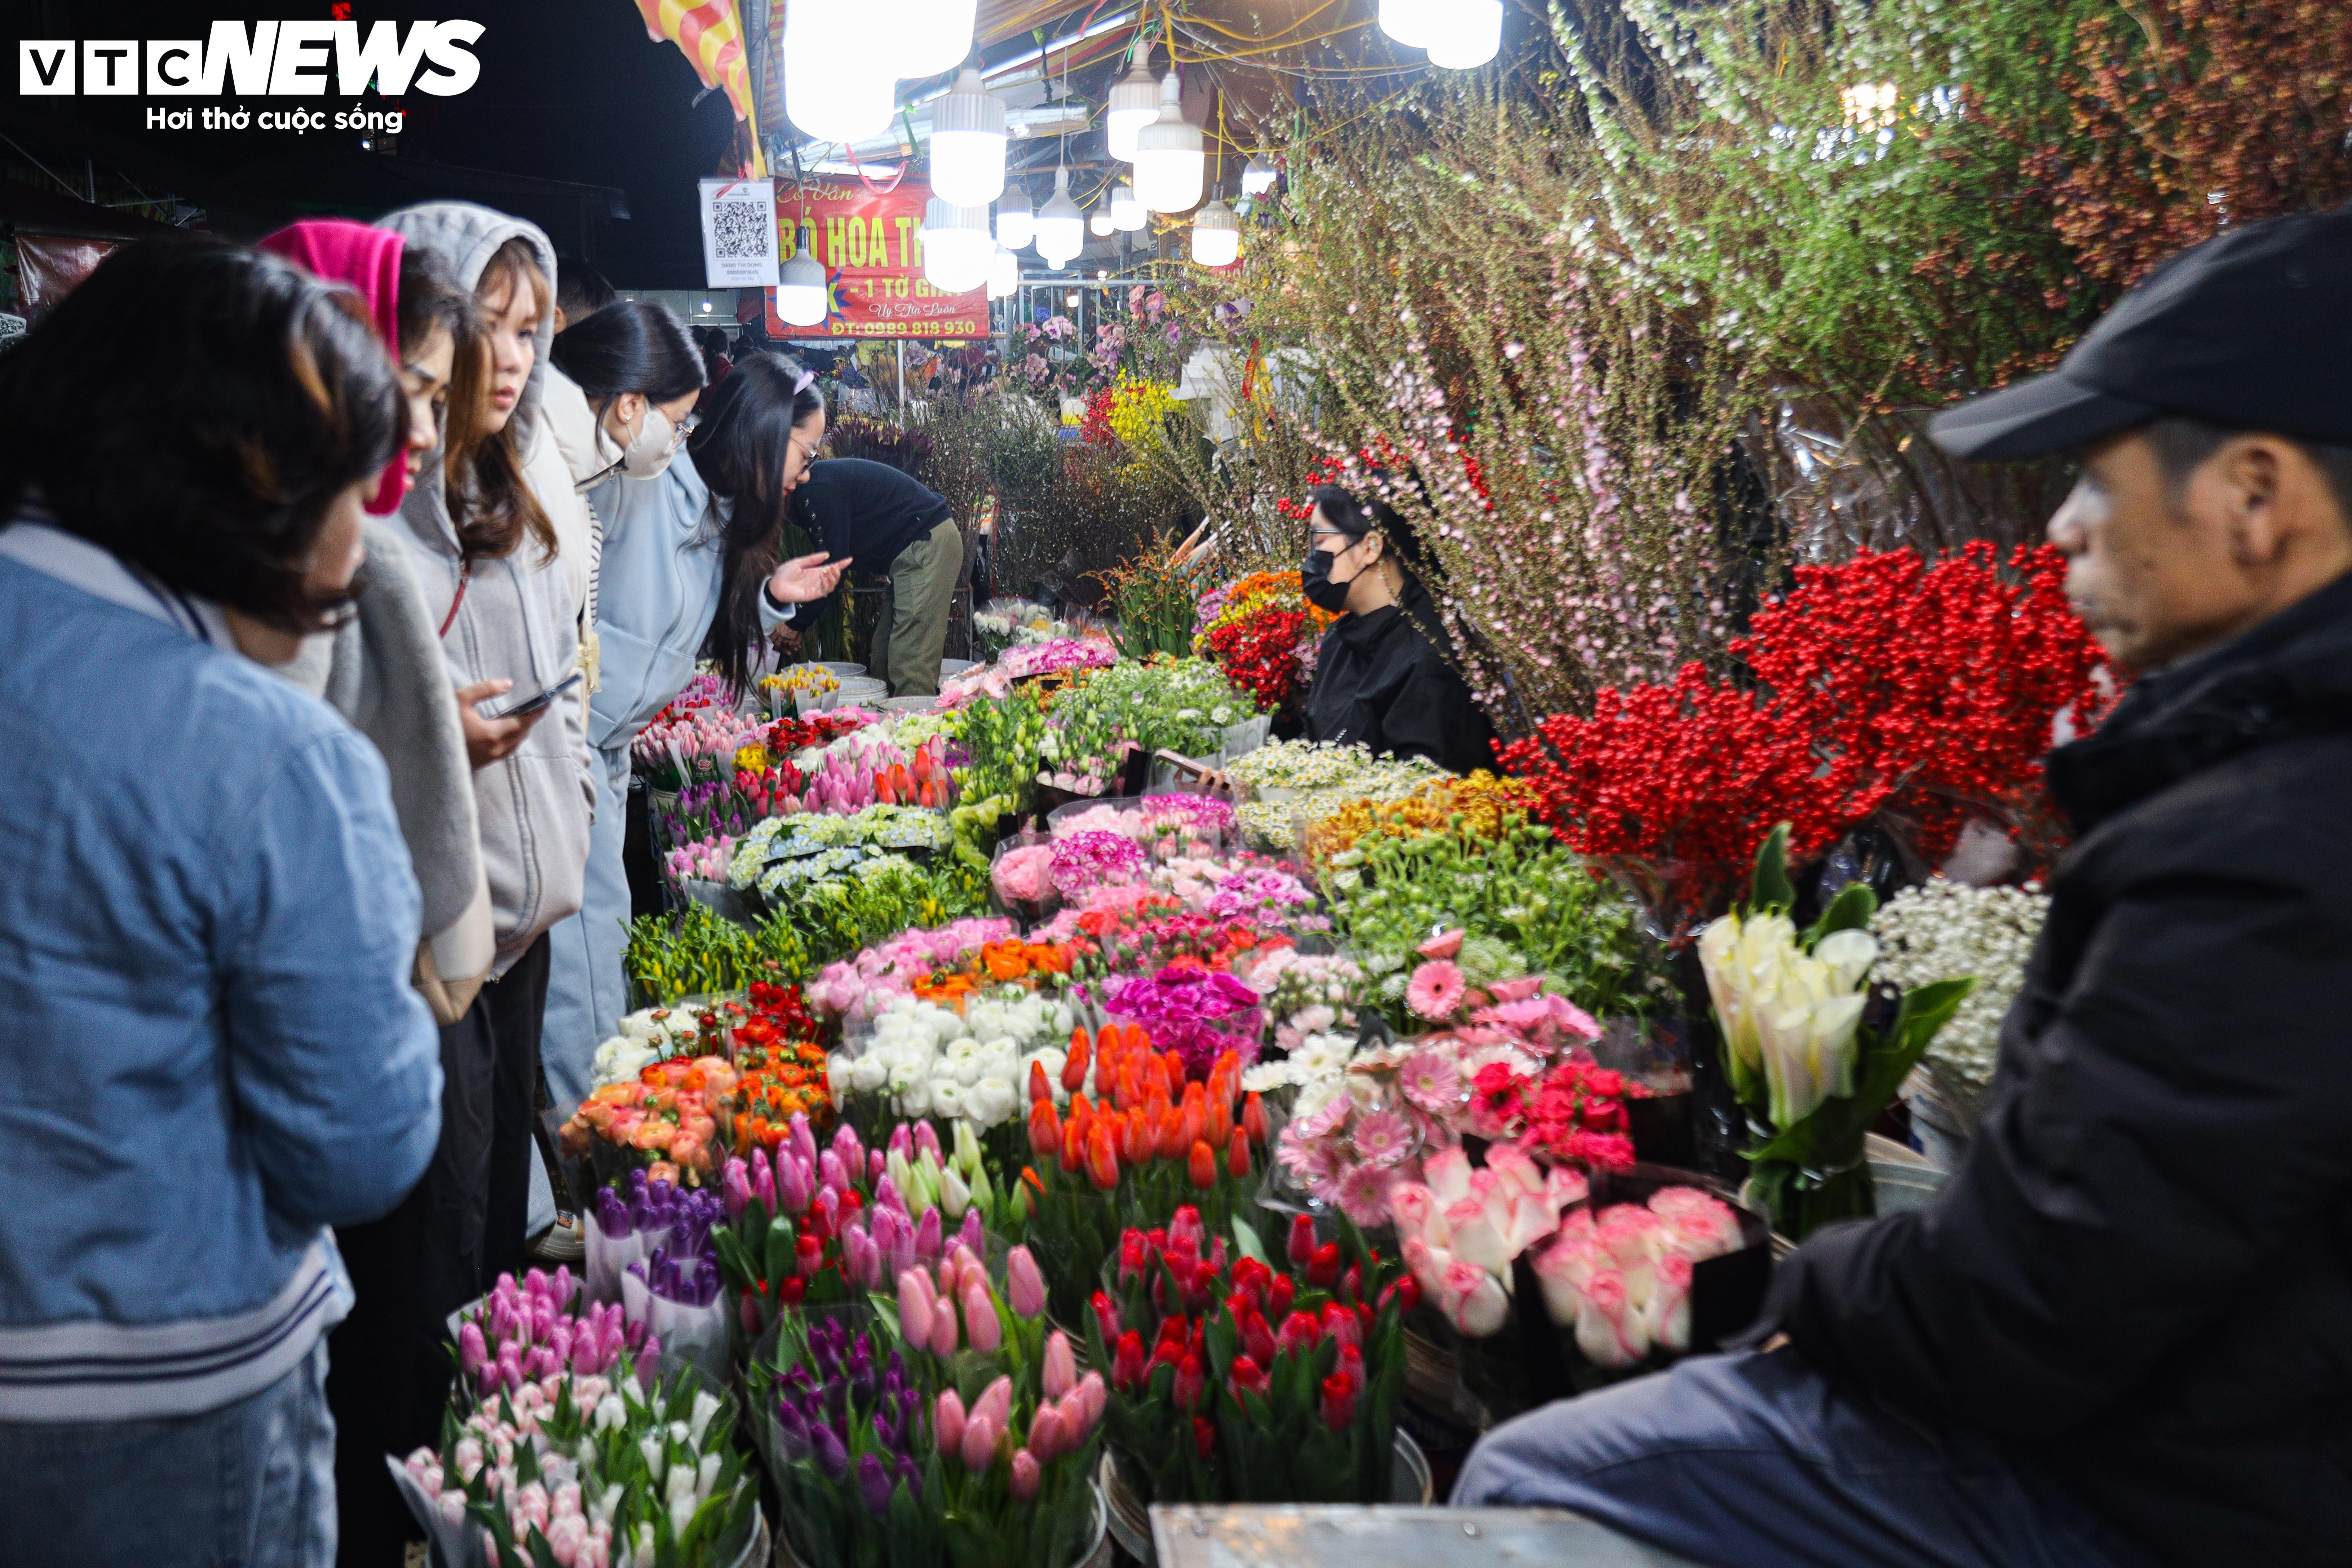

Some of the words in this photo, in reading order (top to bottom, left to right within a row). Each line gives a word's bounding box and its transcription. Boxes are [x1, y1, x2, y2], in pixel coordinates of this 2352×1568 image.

[826, 216, 888, 268] HOA
[864, 279, 874, 298] 1
[882, 274, 909, 298] TỜ
[831, 322, 860, 335] ĐT:
[865, 322, 907, 335] 0989
[911, 321, 940, 335] 818
[944, 321, 976, 335] 930
